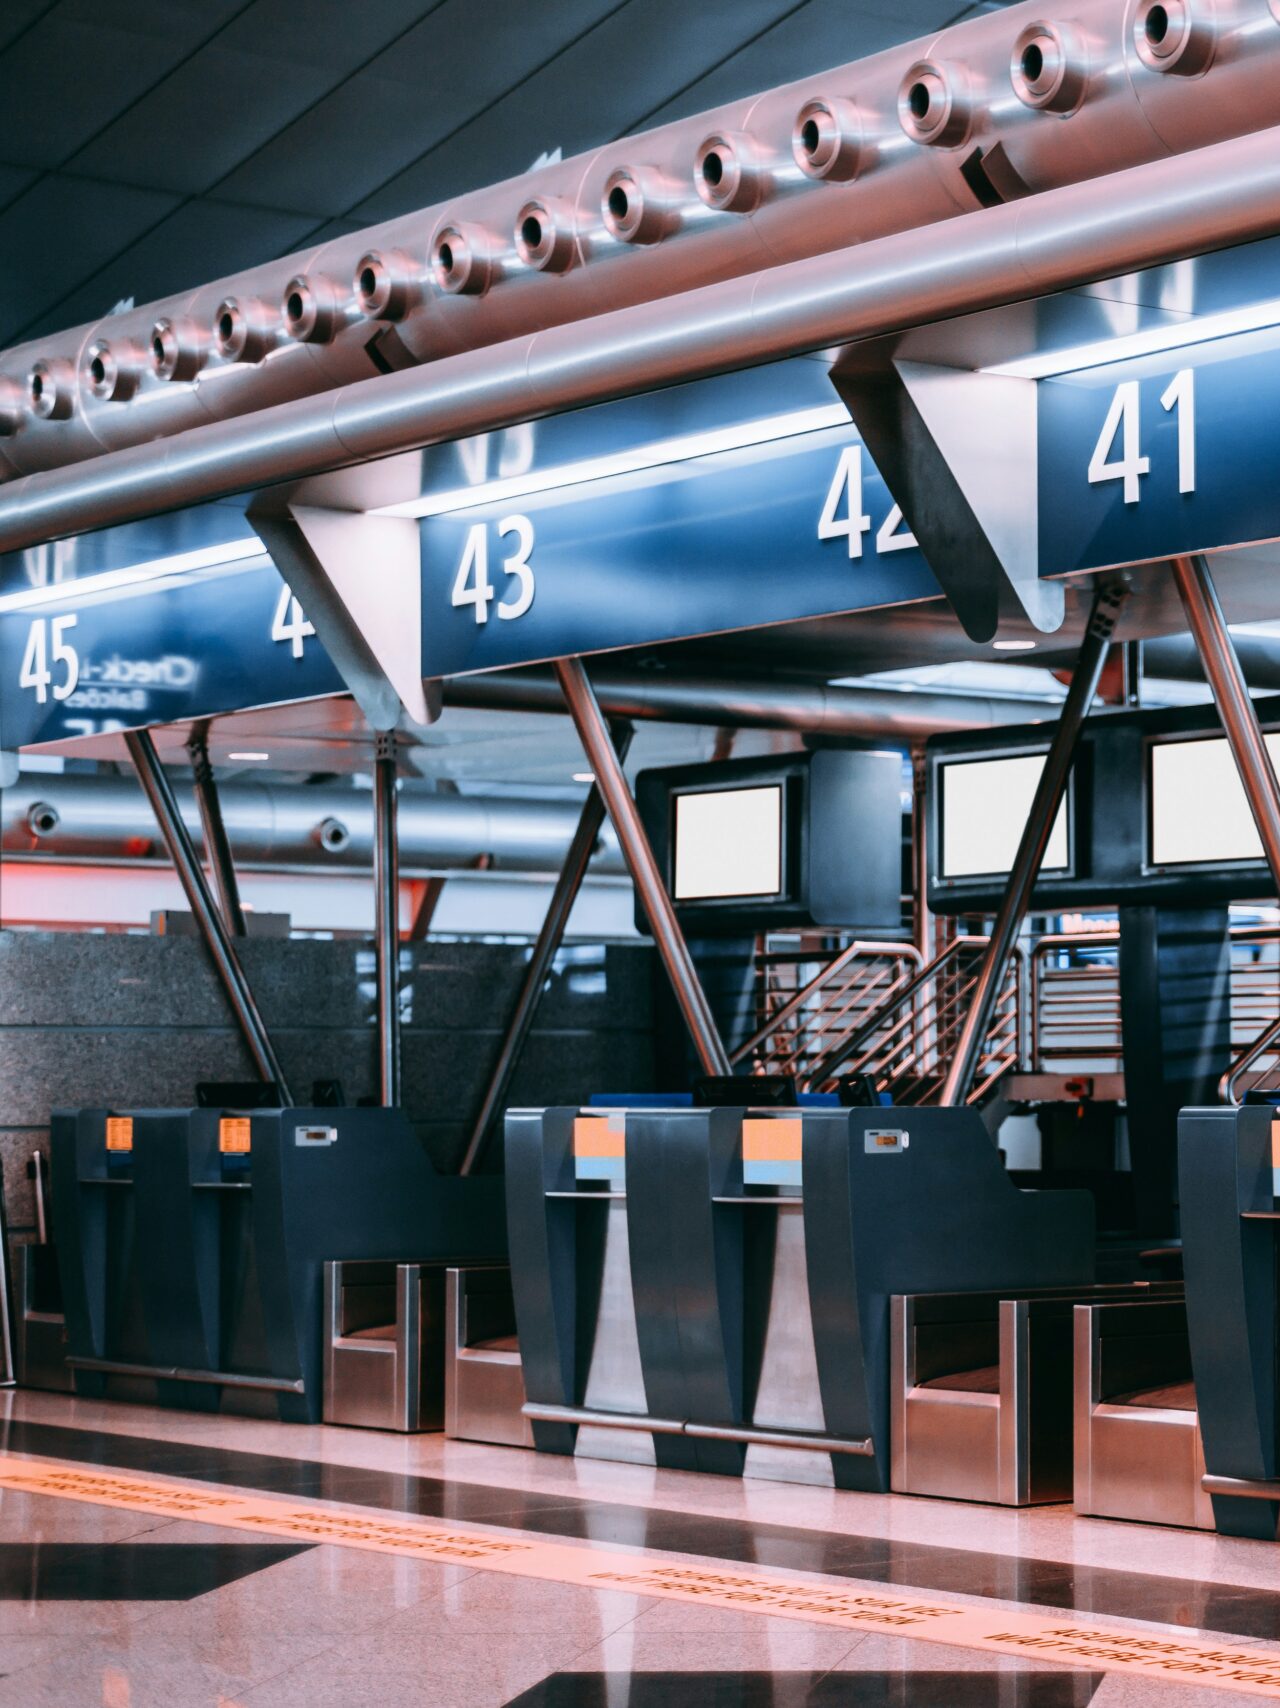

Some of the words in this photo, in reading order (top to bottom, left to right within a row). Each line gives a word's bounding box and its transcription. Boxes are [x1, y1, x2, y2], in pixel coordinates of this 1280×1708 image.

[1087, 368, 1196, 504] 41
[451, 514, 536, 625] 43
[19, 613, 80, 704] 45
[271, 583, 316, 659] 4
[984, 1632, 1073, 1649] WAIT
[1057, 1645, 1157, 1663] HERE
[1142, 1657, 1224, 1674] FOR
[1041, 1628, 1200, 1654] AGUARDE
[1188, 1650, 1280, 1667] AQUI
